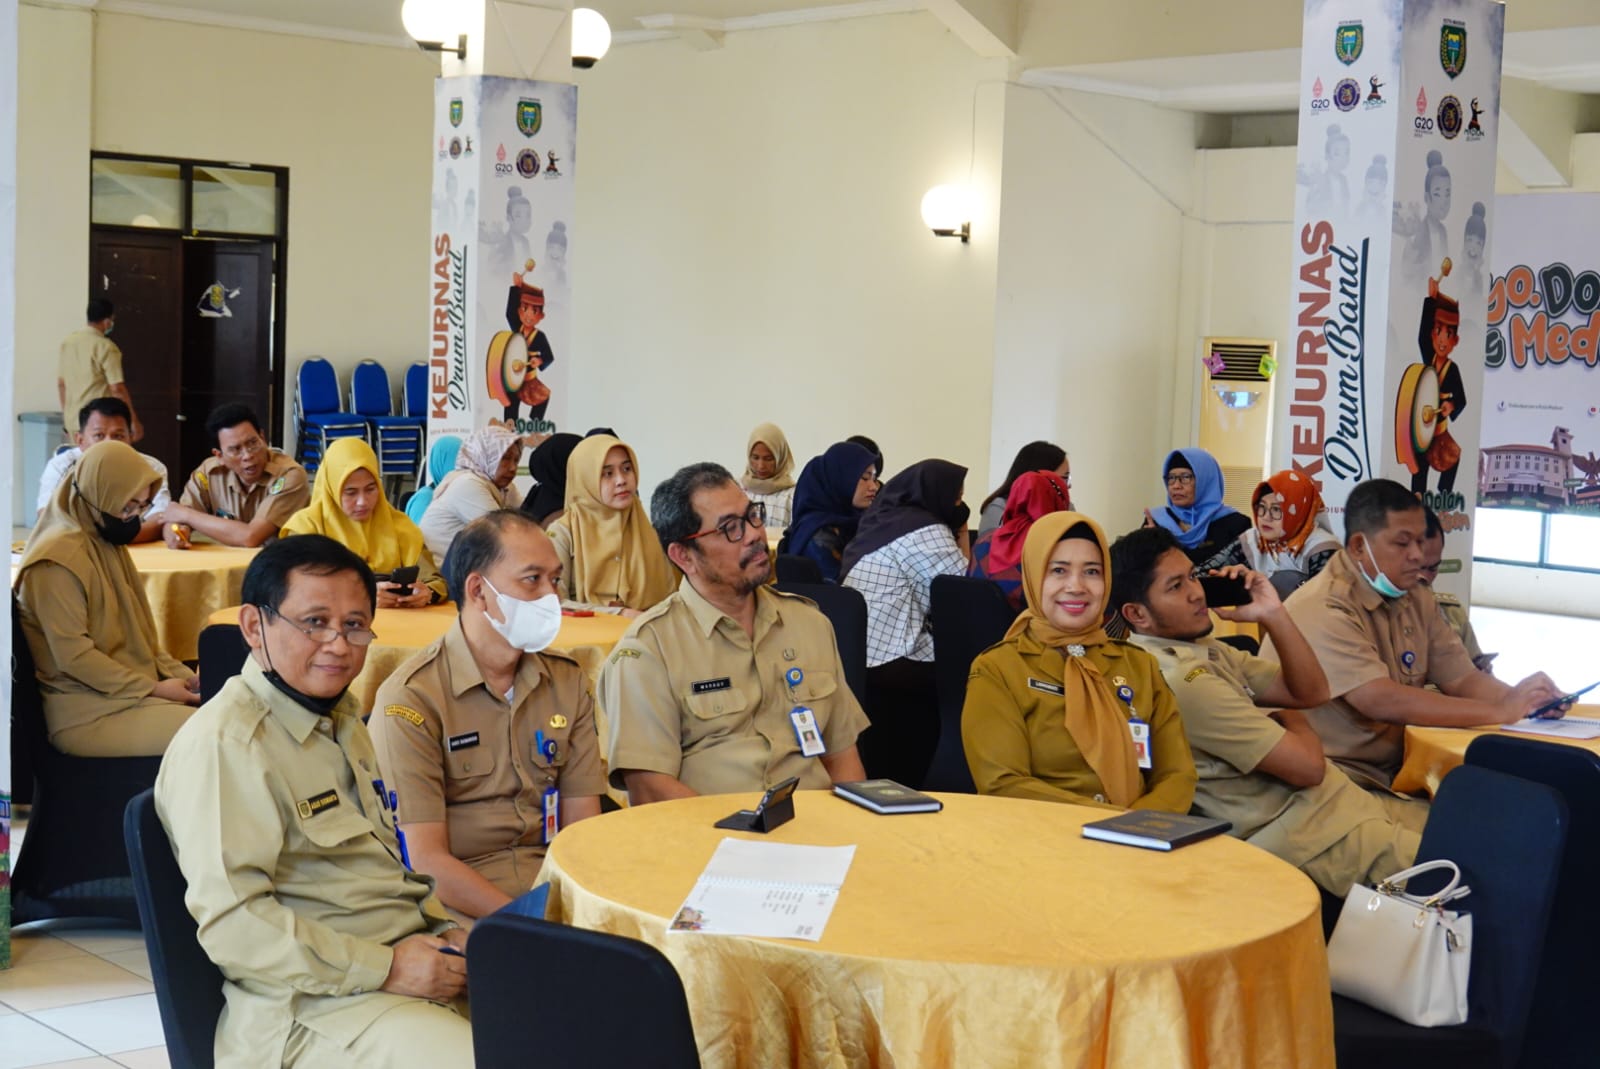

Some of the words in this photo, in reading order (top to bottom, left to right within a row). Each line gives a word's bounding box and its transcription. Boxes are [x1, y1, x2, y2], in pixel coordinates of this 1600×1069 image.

[1311, 99, 1330, 109] G20
[1414, 116, 1434, 130] G20
[495, 163, 513, 173] G20
[431, 233, 450, 419] KEJURNAS
[447, 249, 464, 329] Band
[1324, 244, 1362, 362] Band
[448, 331, 466, 411] Drum
[1290, 220, 1334, 493] KEJURNAS
[516, 418, 556, 435] Dolan
[1324, 363, 1363, 482] Drum
